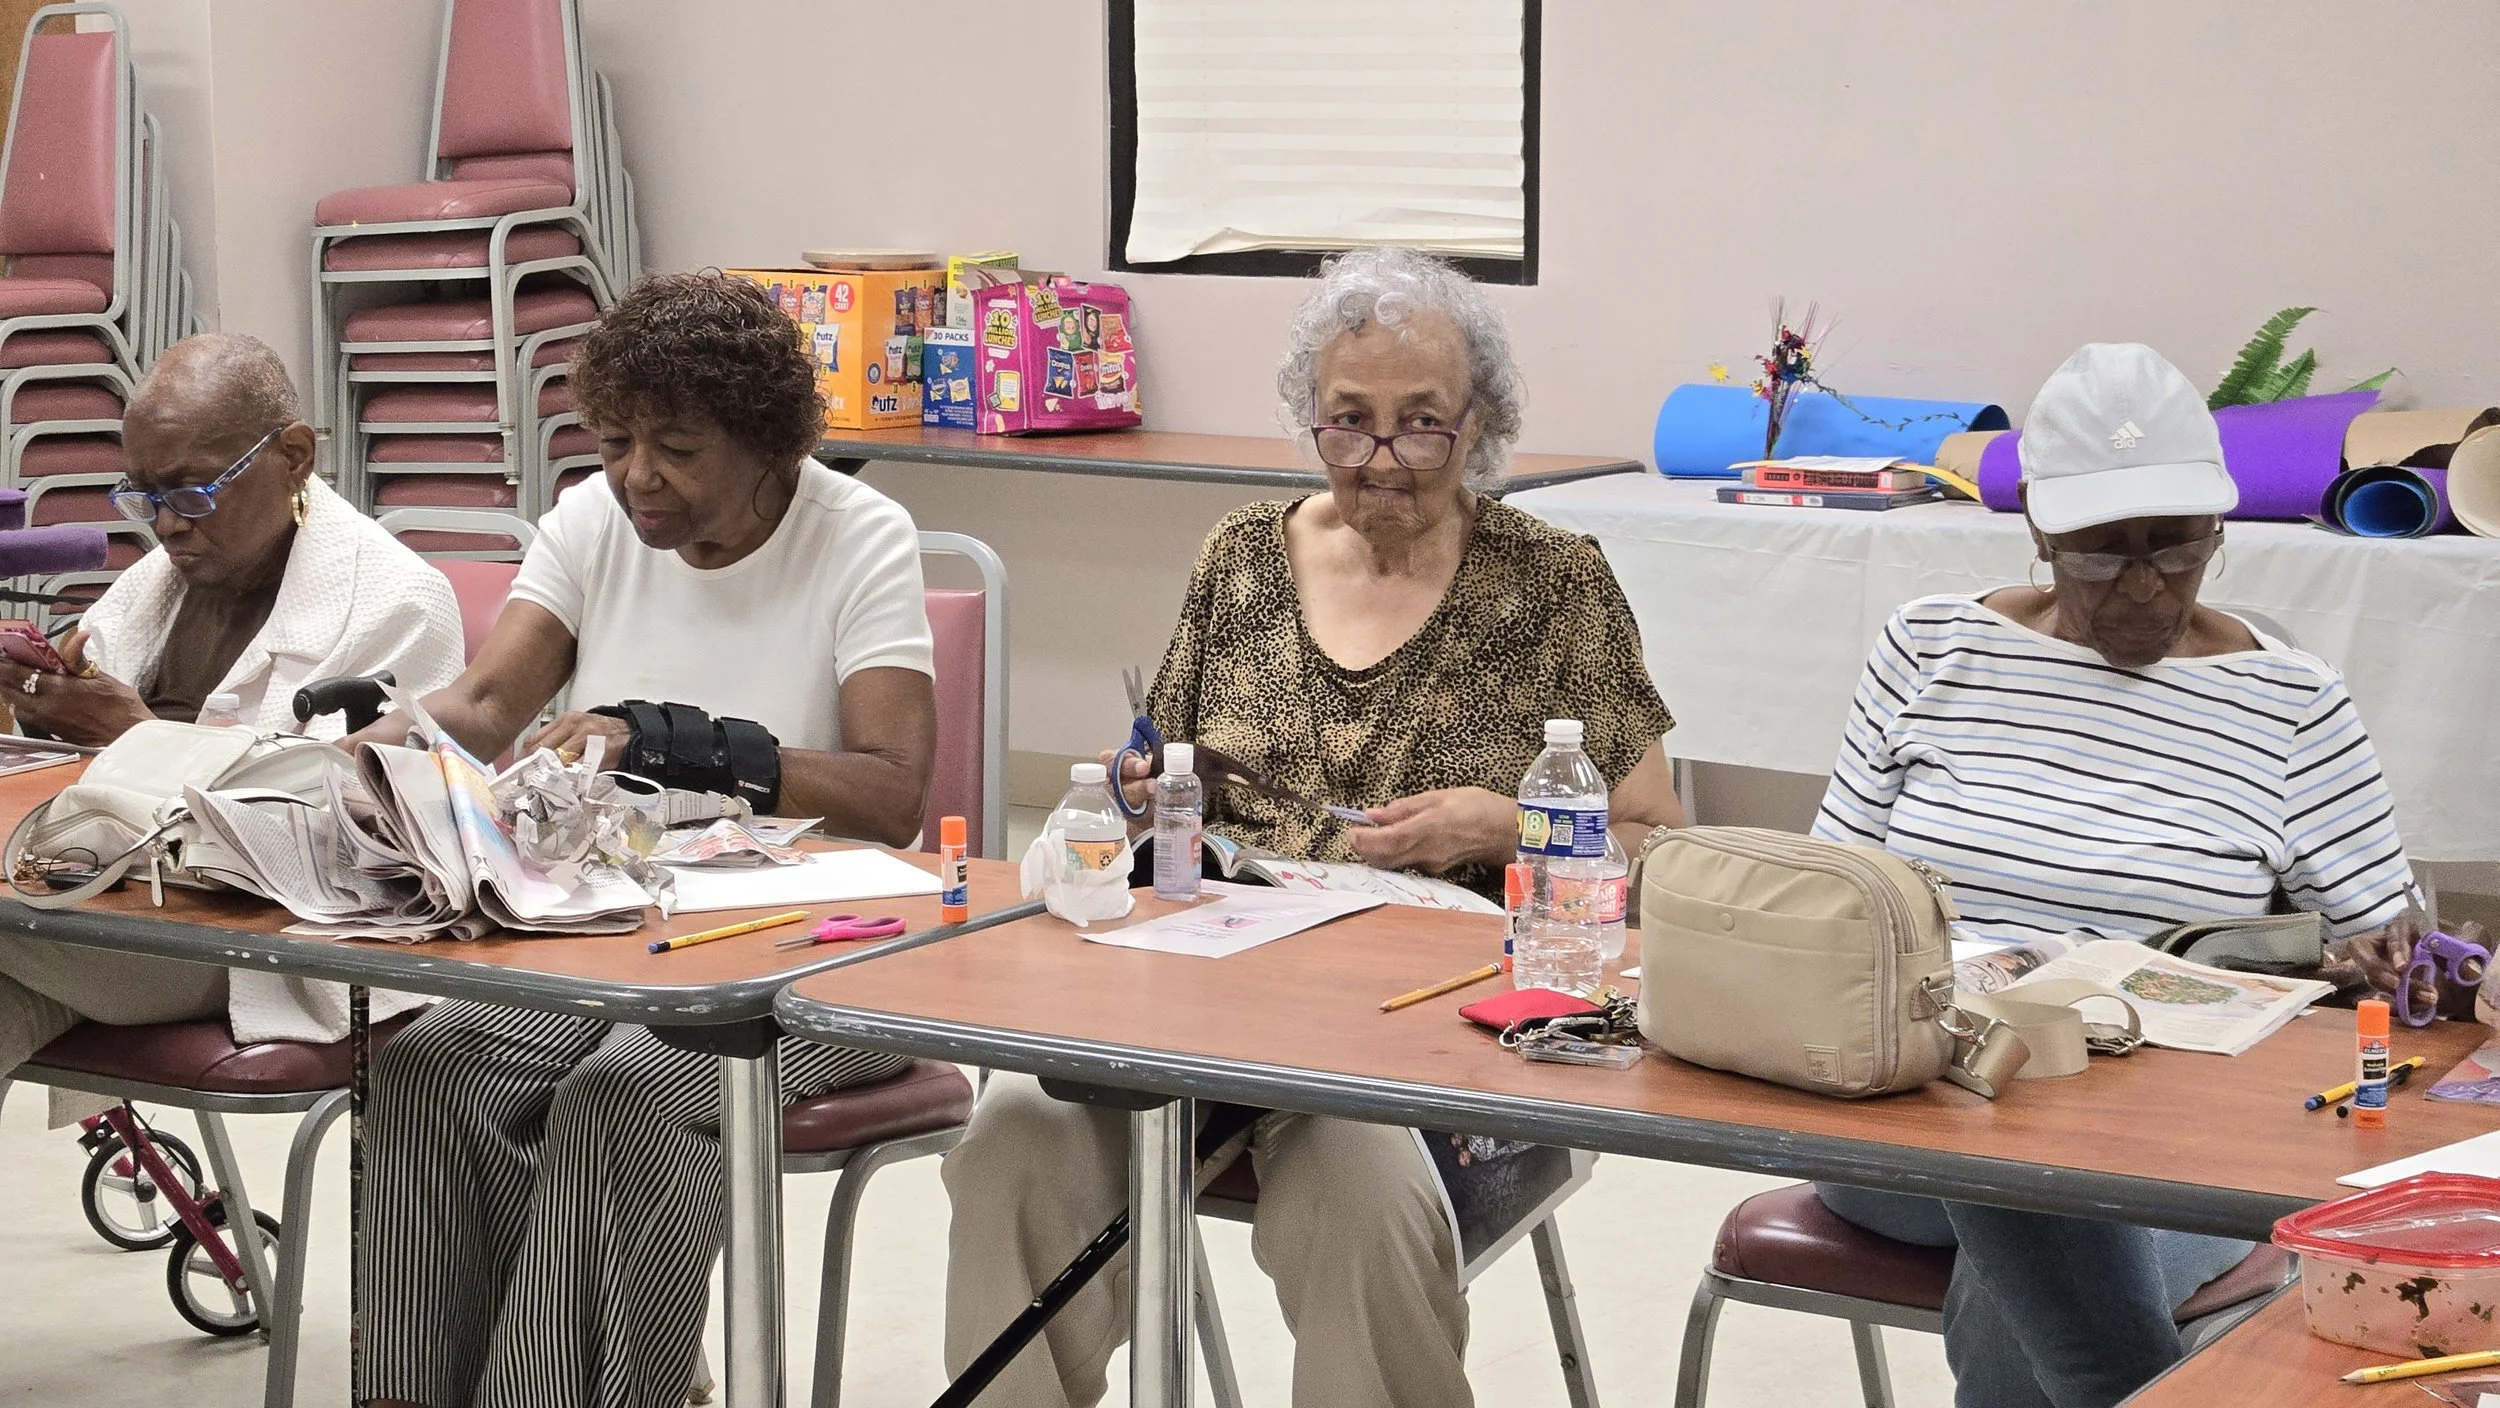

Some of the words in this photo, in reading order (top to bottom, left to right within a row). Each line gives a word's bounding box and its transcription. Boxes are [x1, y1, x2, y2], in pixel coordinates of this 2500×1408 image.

[835, 284, 849, 302] 42
[1036, 289, 1053, 305] 10
[991, 310, 1012, 327] 10
[933, 332, 942, 340] 30
[945, 332, 969, 342] PACKS
[988, 325, 1015, 336] MILLION
[984, 332, 1016, 347] LUNCHES
